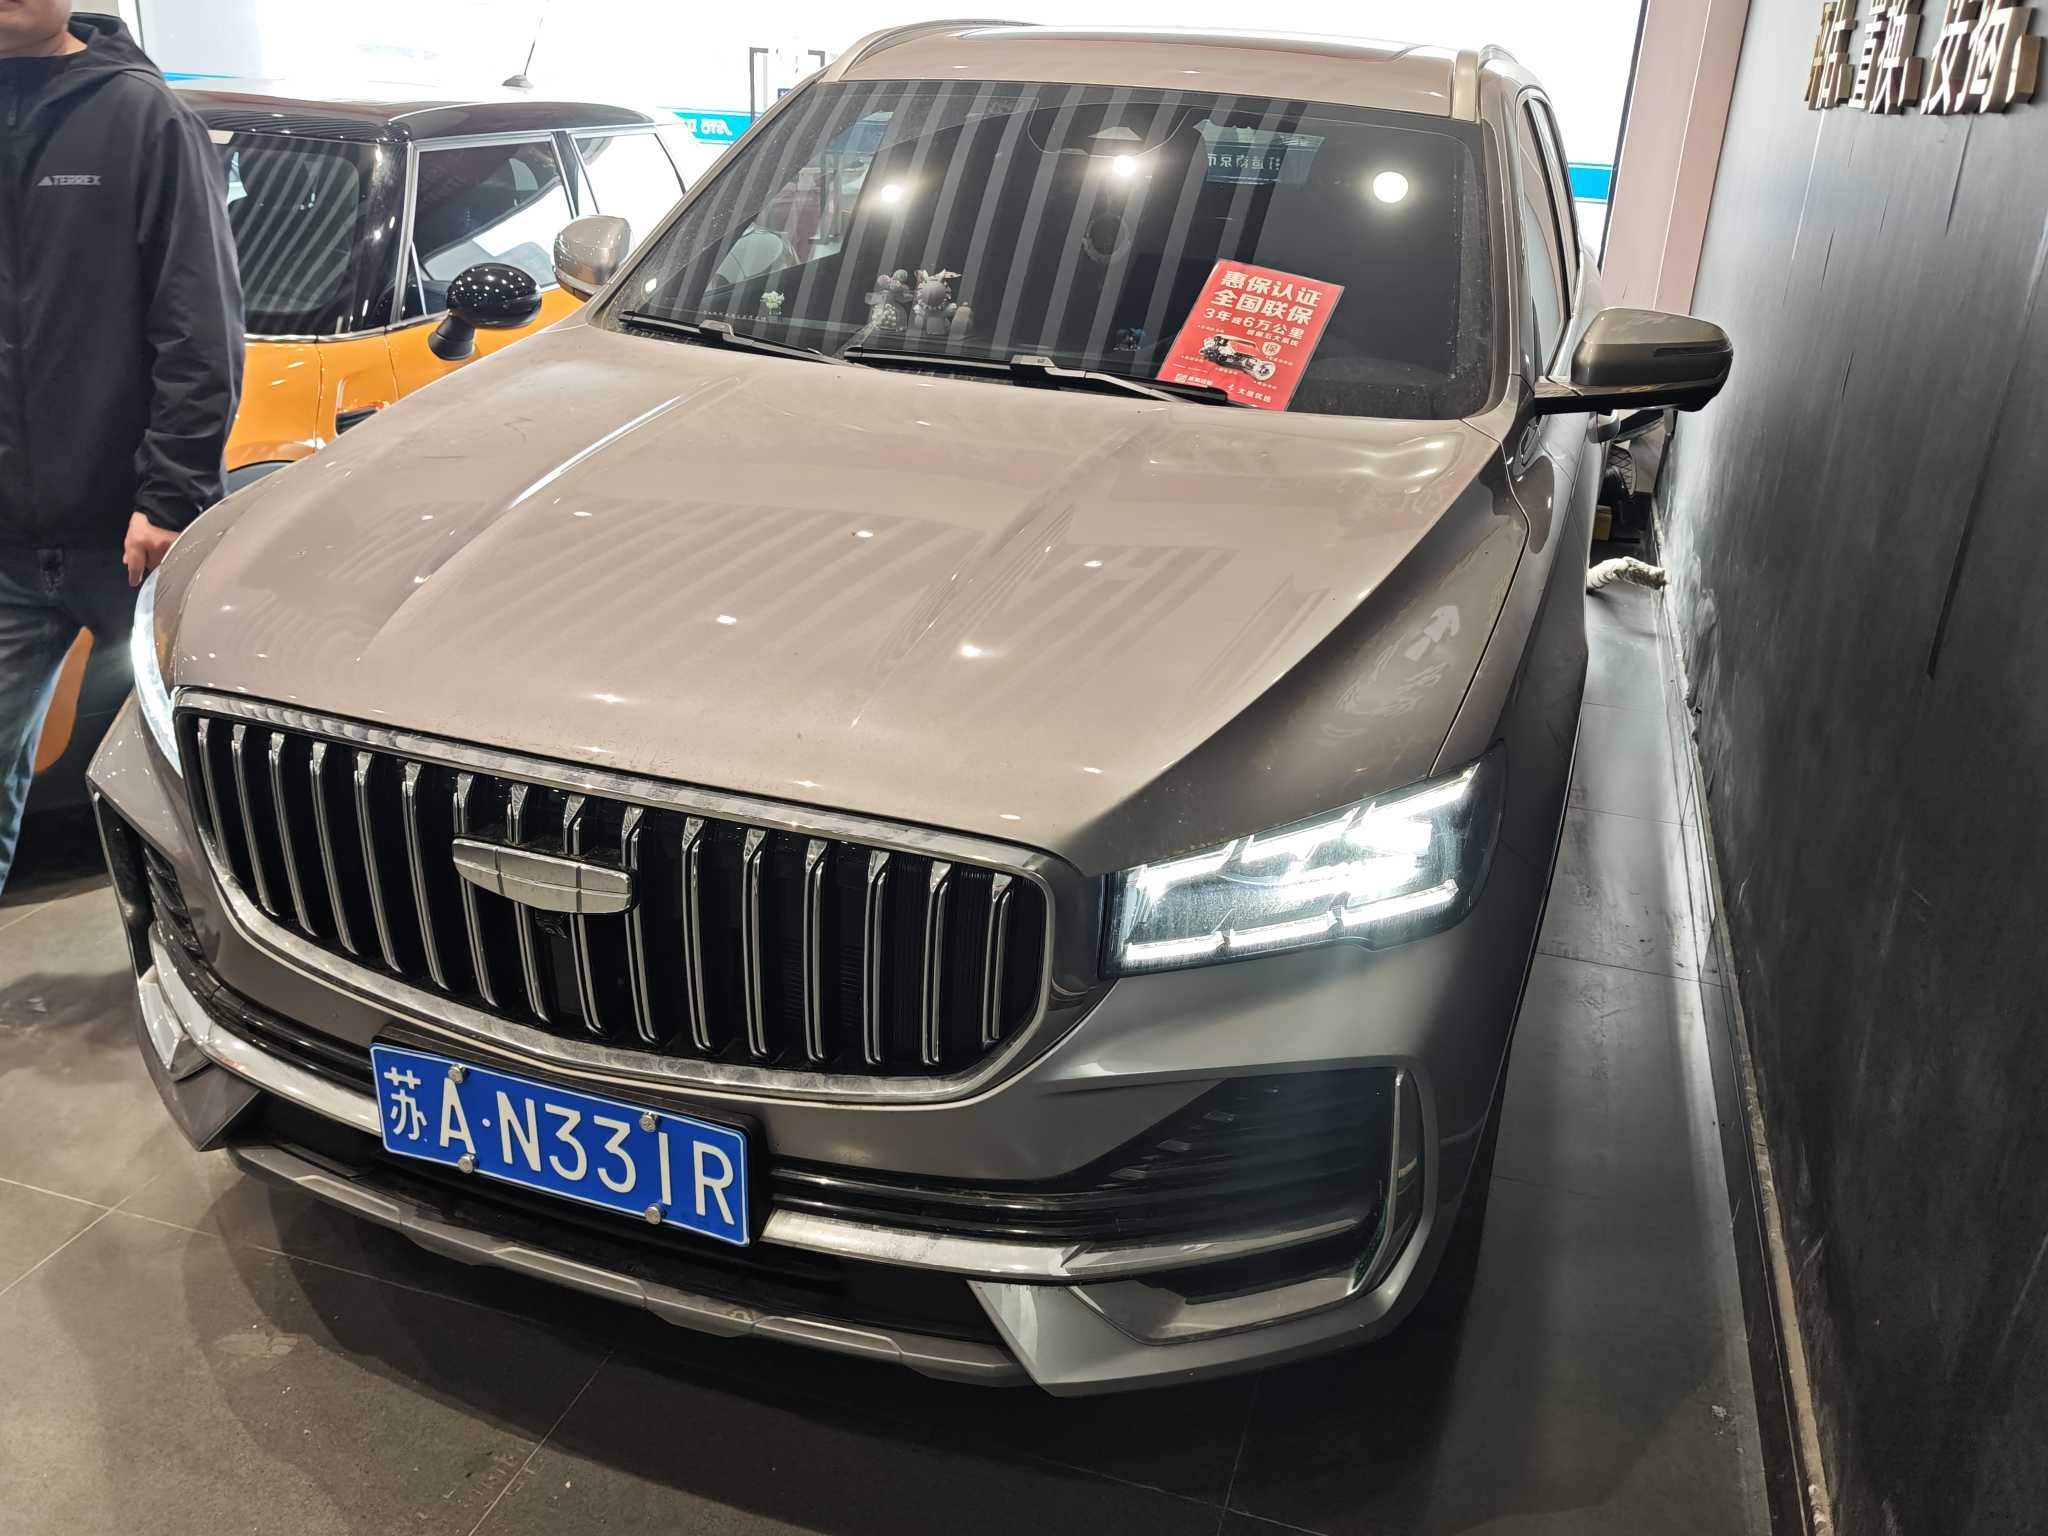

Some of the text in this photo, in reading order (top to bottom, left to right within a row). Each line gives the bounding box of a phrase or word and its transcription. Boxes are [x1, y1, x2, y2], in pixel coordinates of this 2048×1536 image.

[52, 174, 101, 186] TERREX
[1220, 270, 1324, 307] 惠保认证
[1211, 289, 1314, 326] 全国联保
